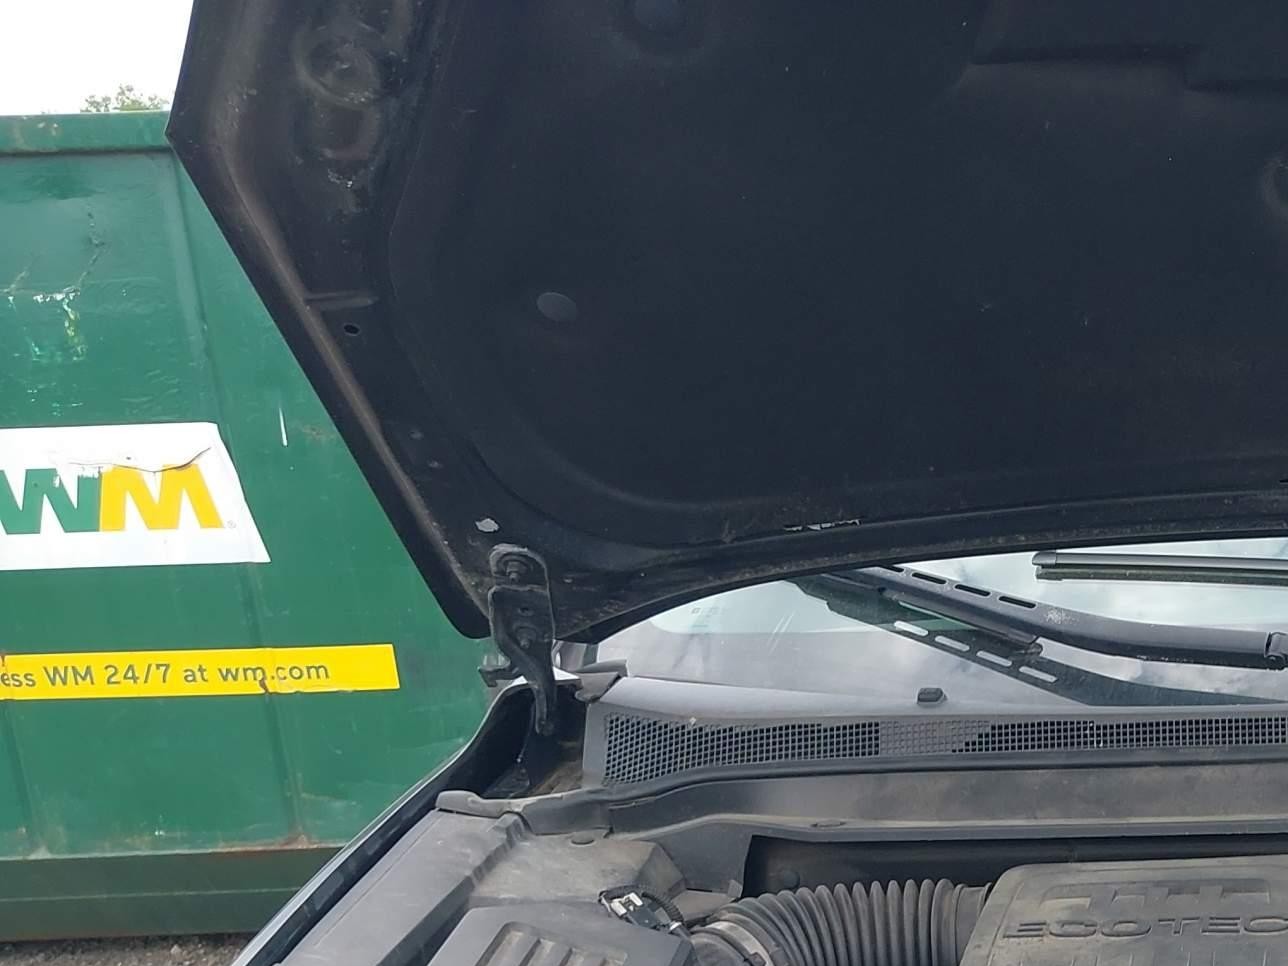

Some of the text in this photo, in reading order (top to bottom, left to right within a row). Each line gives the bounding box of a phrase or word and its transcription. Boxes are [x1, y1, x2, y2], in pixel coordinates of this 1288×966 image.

[0, 464, 225, 535] WM
[44, 666, 95, 686] WM
[105, 663, 171, 686] 24/7
[183, 664, 208, 683] at
[218, 662, 330, 683] wm.com
